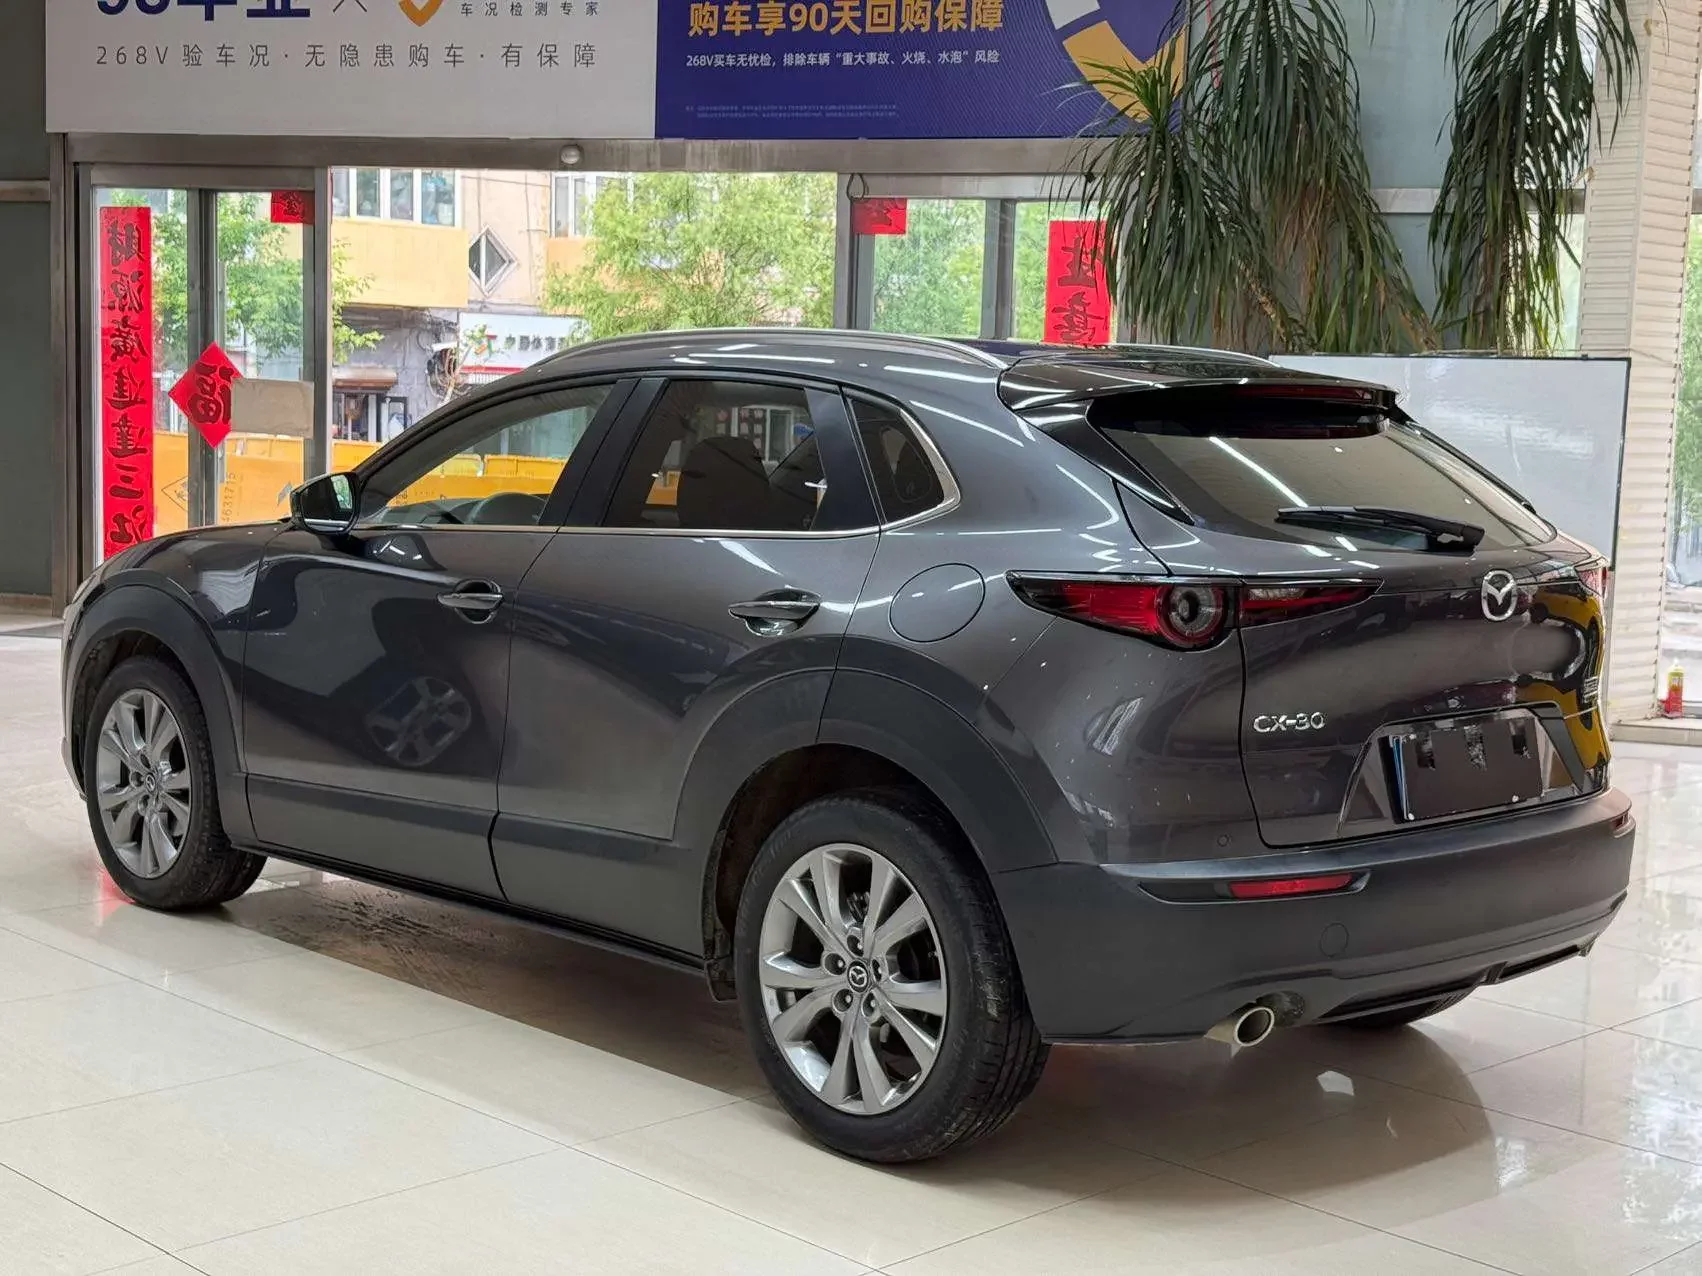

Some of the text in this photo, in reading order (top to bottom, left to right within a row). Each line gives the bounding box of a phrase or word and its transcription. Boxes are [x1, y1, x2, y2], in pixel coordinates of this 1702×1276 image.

[460, 2, 600, 16] 车况检测专家
[688, 0, 1004, 36] 购车享90天回购保障
[1253, 712, 1326, 733] CX-30
